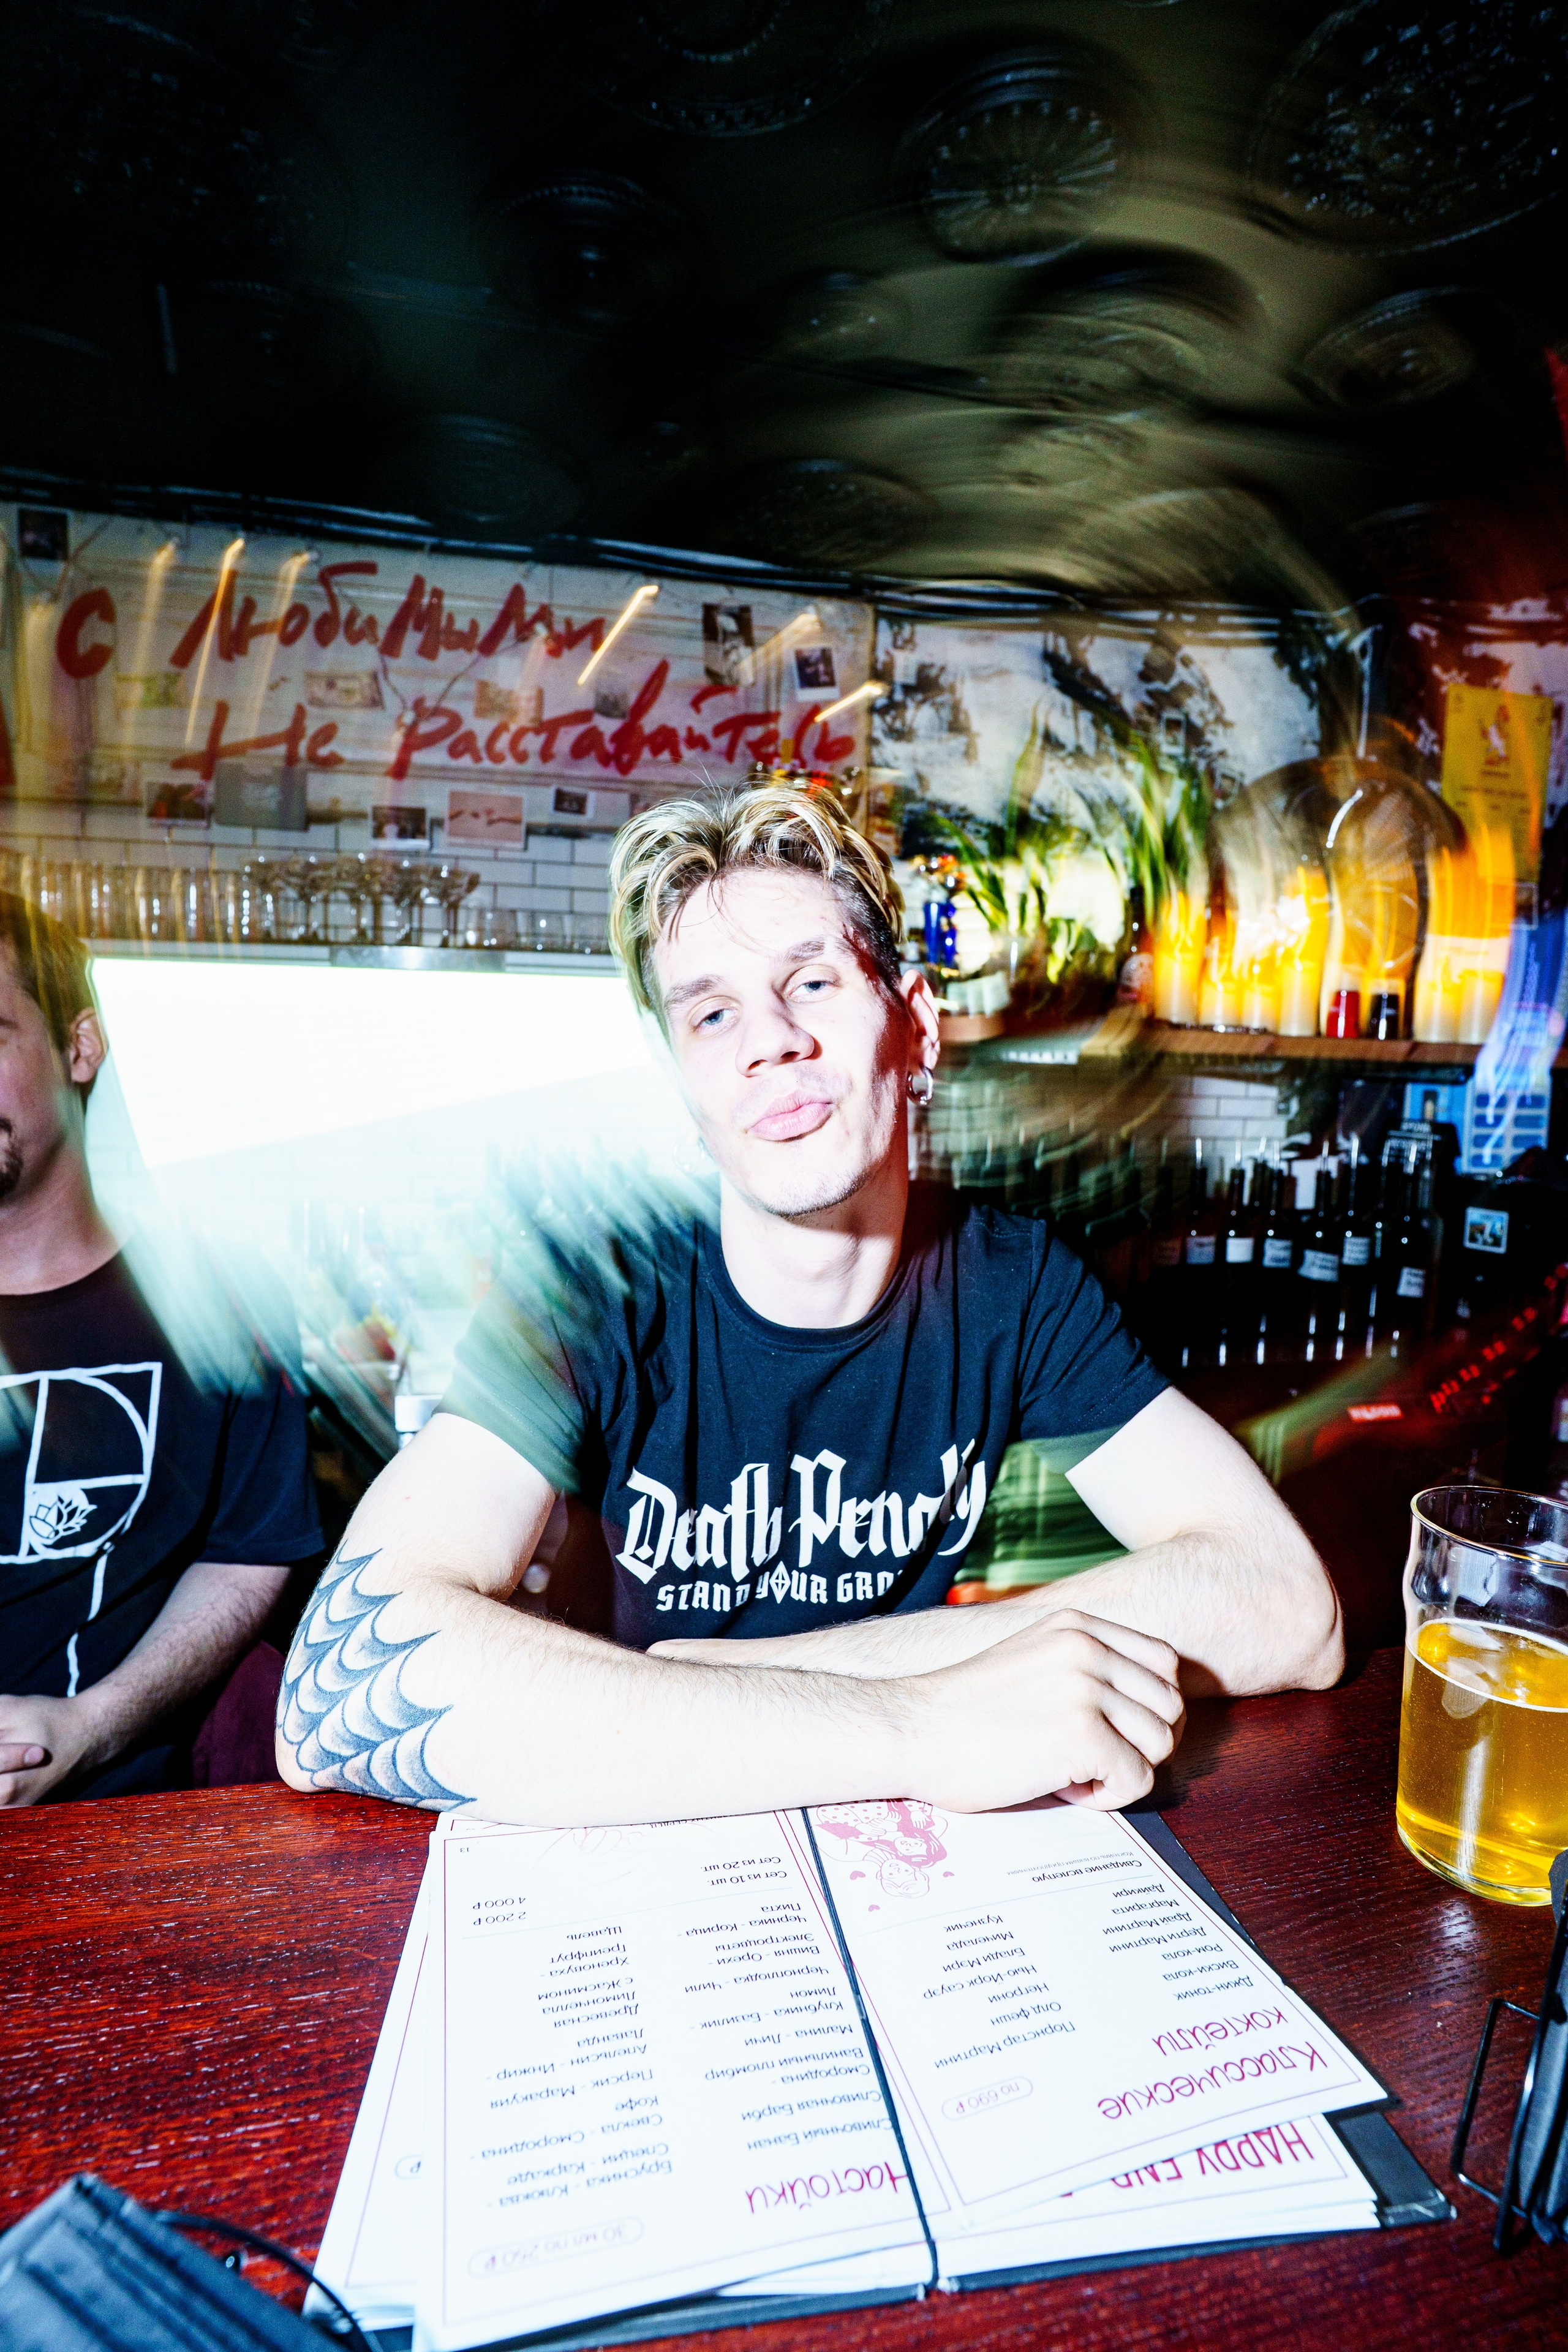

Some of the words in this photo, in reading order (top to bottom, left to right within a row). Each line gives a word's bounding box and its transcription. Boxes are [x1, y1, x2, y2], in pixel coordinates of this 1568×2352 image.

[171, 700, 344, 781] Не
[616, 1463, 782, 1584] Death
[655, 1580, 751, 1612] STAND
[700, 1864, 719, 1873] шт.
[723, 1861, 739, 1870] 20
[1006, 1861, 1065, 1876] предпочтениям
[1065, 1857, 1089, 1866] вашим
[1084, 1860, 1142, 1874] Свидание
[707, 1878, 726, 1887] шт.
[764, 1871, 787, 1879] Сет
[1031, 1868, 1083, 1883] вслепую
[1112, 1883, 1166, 1899] Дайкири
[760, 1902, 801, 1915] Пихта
[1111, 1898, 1180, 1915] Маргарита
[748, 1914, 807, 1928] Черника
[943, 1914, 1004, 1933] Кузнечик
[1101, 1915, 1160, 1936] Мартини
[1158, 1911, 1193, 1926] Драй
[566, 1926, 622, 1941] Щавель
[685, 1922, 737, 1938] Корица
[1167, 1926, 1207, 1941] Дерти
[715, 1932, 814, 1953] Электроцветы
[774, 1945, 820, 1958] Вишня
[946, 1931, 1014, 1953] Мичелада
[1108, 1931, 1167, 1953] Мартини
[717, 1951, 763, 1966] Орехи
[982, 1947, 1026, 1964] Блади
[1161, 1943, 1223, 1962] Ром-кола
[549, 1956, 629, 1978] Хреновуха
[733, 1966, 829, 1985] Черноплодка
[942, 1957, 982, 1974] Мэри
[1162, 1959, 1239, 1983] Виски-кола
[625, 1977, 633, 1985] с
[966, 1964, 1038, 1989] Нью-Йорк
[537, 1980, 620, 2002] Жасмином
[684, 1981, 722, 1994] Чили
[790, 1986, 836, 1999] Лимон
[922, 1983, 965, 2000] сауэр
[987, 1983, 1049, 2004] Негрони
[1173, 1975, 1254, 2002] Джин-тоник
[541, 1991, 636, 2016] Лимончелла
[774, 2000, 843, 2017] Клубника
[1030, 2000, 1061, 2015] Олд
[553, 2003, 639, 2029] Древесная
[699, 2012, 761, 2031] Базилик
[990, 2008, 1030, 2027] фешн
[577, 2028, 644, 2049] Лаванда
[744, 2033, 782, 2046] Личи
[794, 2024, 853, 2040] Малина
[1003, 2021, 1076, 2047] Порнстар
[1152, 2007, 1288, 2056] коктейли
[570, 2044, 647, 2067] Апельсин
[778, 2047, 864, 2069] Ванильный
[933, 2041, 1002, 2070] Мартини
[496, 2062, 555, 2082] Инжир
[590, 2068, 653, 2090] Персик
[704, 2059, 775, 2081] пломбир
[780, 2064, 871, 2084] Смородина
[1097, 2041, 1328, 2119] Классические
[489, 2085, 575, 2111] Маракуйя
[1000, 2081, 1020, 2096] по
[614, 2095, 658, 2113] Кофе
[796, 2090, 881, 2111] Сливочная
[967, 2089, 999, 2109] 690
[740, 2103, 794, 2124] Барби
[600, 2113, 663, 2135] Свекла
[802, 2117, 894, 2141] Сливочный
[481, 2130, 585, 2161] Смородина
[745, 2132, 801, 2152] Банан
[1196, 2122, 1314, 2174] HAPPY
[601, 2143, 669, 2166] Специи
[506, 2160, 585, 2187] Каркаде
[586, 2160, 672, 2188] Брусника
[498, 2183, 569, 2209] Клюква
